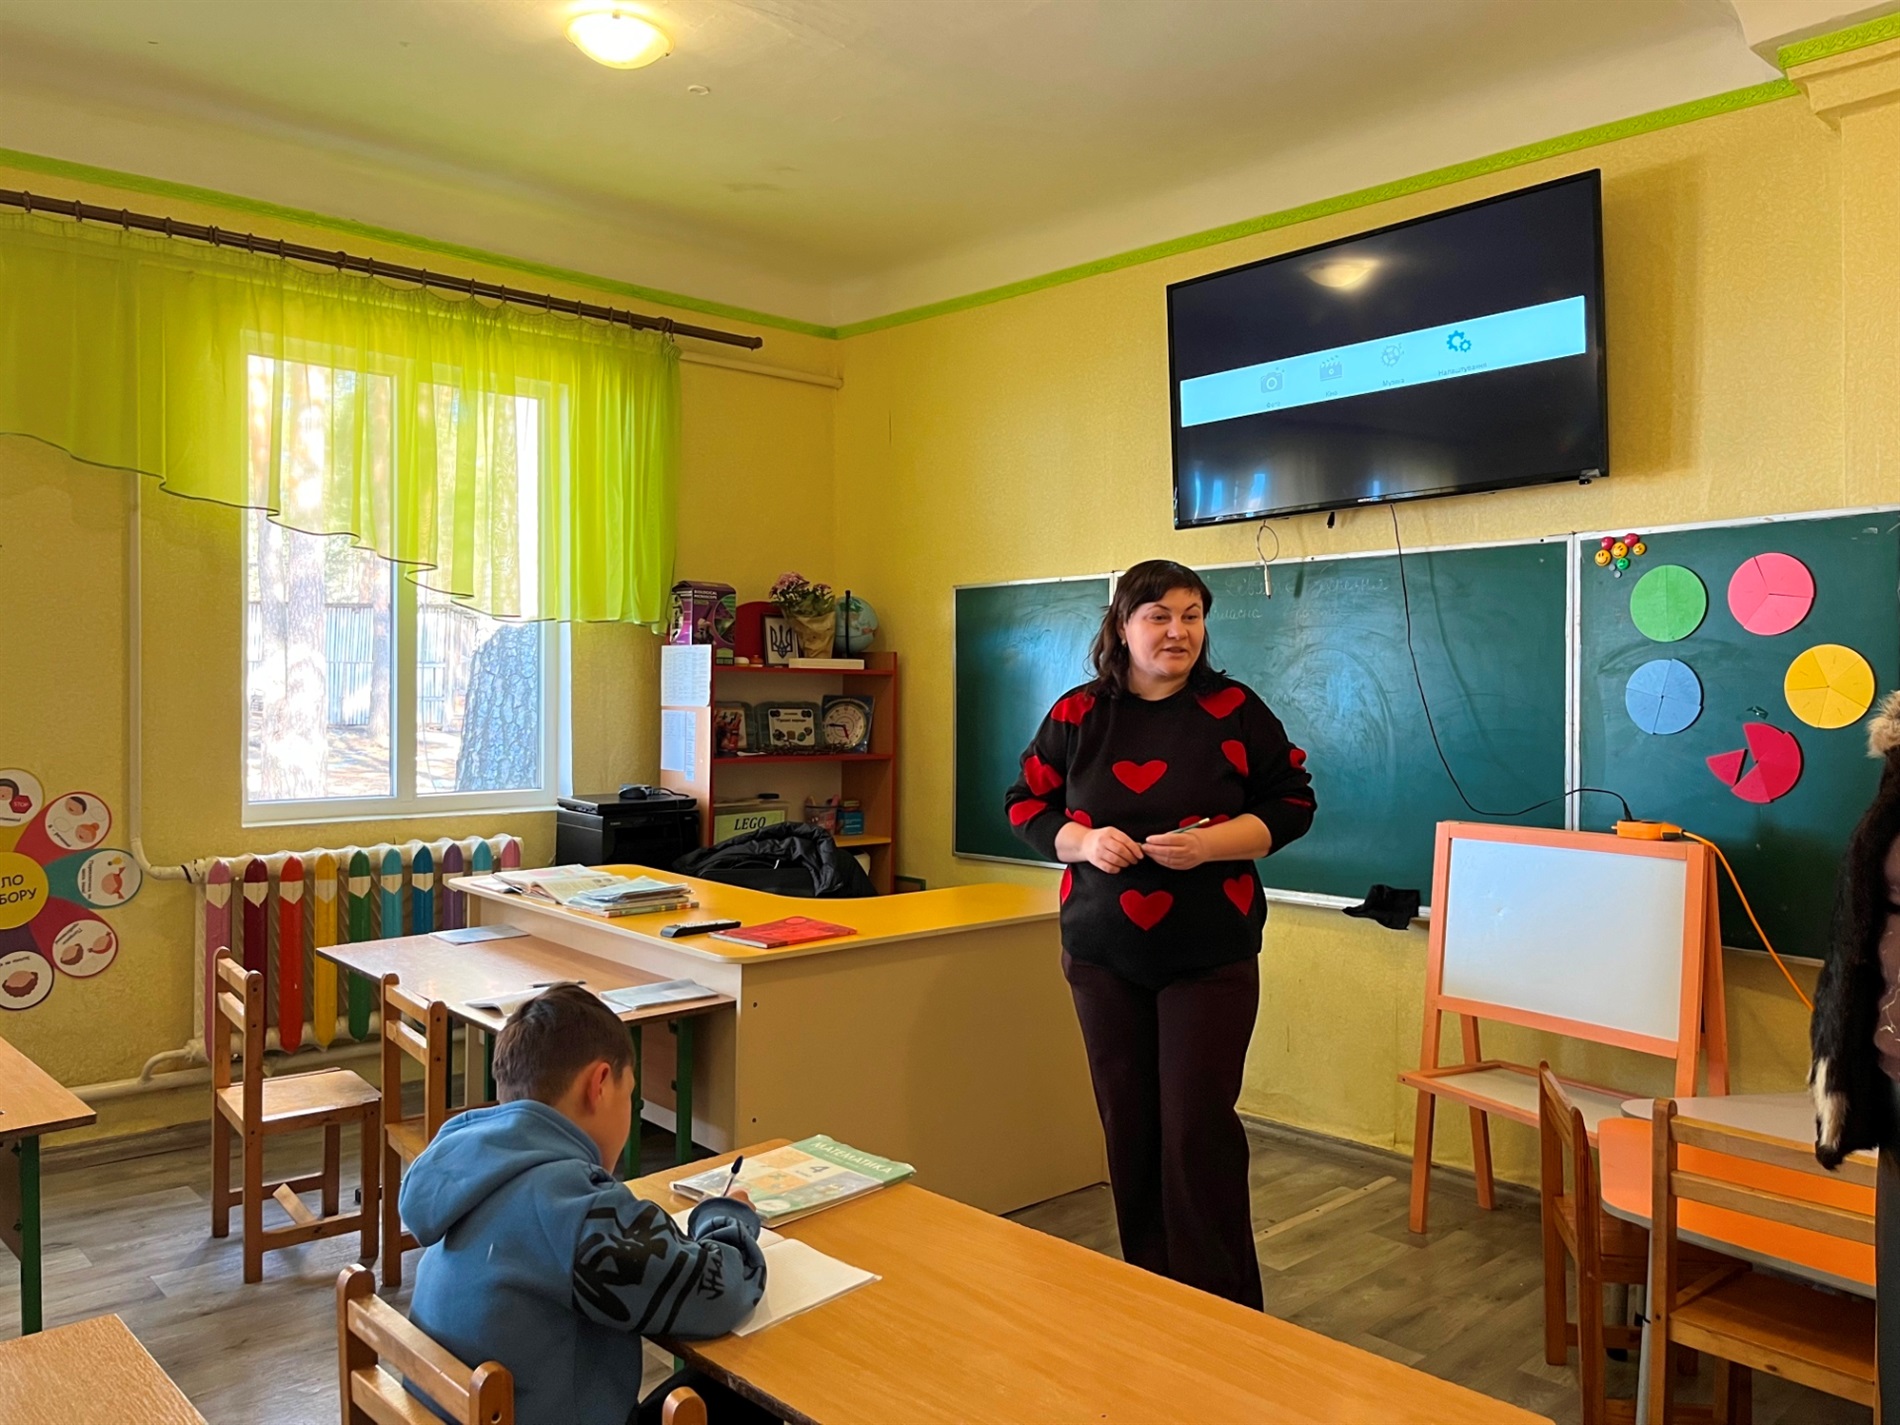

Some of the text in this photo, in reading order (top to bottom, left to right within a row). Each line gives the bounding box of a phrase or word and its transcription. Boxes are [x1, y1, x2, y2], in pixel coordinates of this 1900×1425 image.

[734, 816, 766, 831] LEGO
[0, 887, 37, 906] БОРУ
[811, 1141, 893, 1174] МАТЕМАТИКА
[809, 1165, 830, 1174] 4
